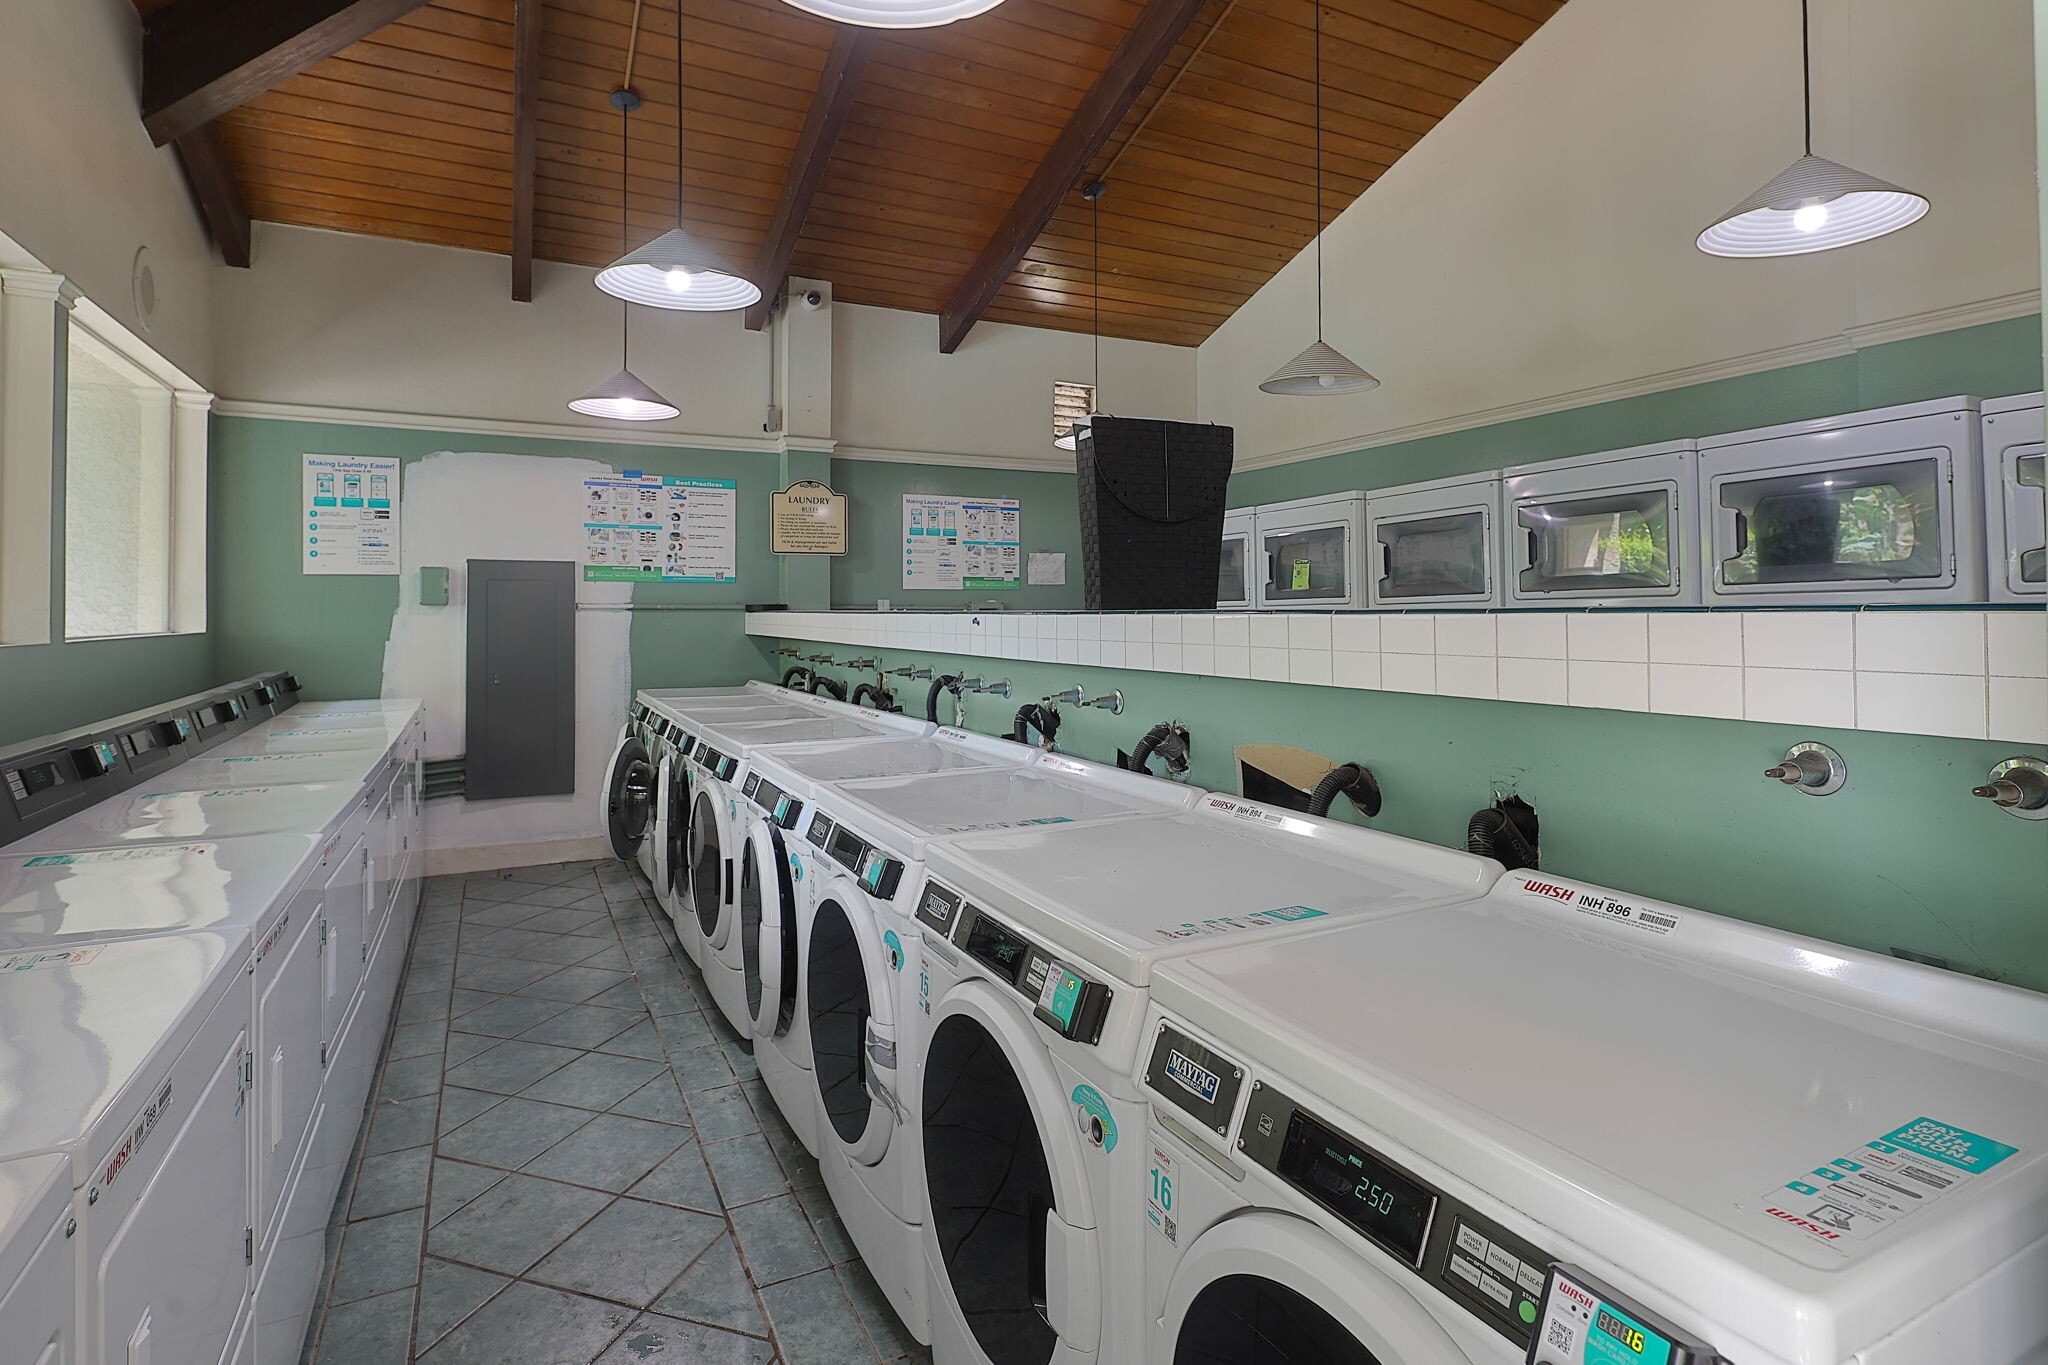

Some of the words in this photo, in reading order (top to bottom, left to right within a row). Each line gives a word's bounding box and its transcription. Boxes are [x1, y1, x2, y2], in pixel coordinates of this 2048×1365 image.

[308, 460, 336, 468] Making
[337, 461, 368, 470] Laundry
[788, 496, 830, 504] LAUNDRY
[1210, 799, 1236, 811] WASH
[1236, 806, 1250, 815] INH
[1524, 880, 1575, 900] WASH
[1578, 895, 1604, 910] INH
[1606, 902, 1631, 917] 896
[920, 972, 928, 997] 15
[1068, 980, 1075, 990] 15
[1169, 1053, 1215, 1092] MAYTAG
[1173, 1070, 1203, 1094] COMMERCIAL
[1913, 1124, 1974, 1148] WITH
[1920, 1121, 1964, 1136] PAY
[1897, 1132, 1980, 1164] PHONE
[1908, 1128, 1968, 1154] YOUR
[106, 1136, 132, 1186] WASH
[1154, 1147, 1171, 1165] WASH
[1324, 1147, 1337, 1160] SELECT
[1336, 1154, 1348, 1166] CYCLE
[1348, 1154, 1364, 1168] PRICE
[1868, 1154, 1896, 1165] WASH
[1151, 1168, 1172, 1211] 16
[1354, 1176, 1394, 1215] 2.50
[1766, 1208, 1840, 1240] WASH
[1463, 1231, 1483, 1247] POWER
[1463, 1238, 1480, 1252] WASH
[1453, 1260, 1479, 1280] TEMPERATURE
[1473, 1260, 1494, 1276] OPTIONS
[1490, 1252, 1515, 1271] NORMAL
[1520, 1270, 1543, 1289] DELICAT
[1483, 1280, 1496, 1292] EXTRA
[1496, 1289, 1509, 1300] RINSE
[1522, 1291, 1539, 1306] START
[1559, 1282, 1594, 1308] WASH
[1626, 1328, 1645, 1352] 16
